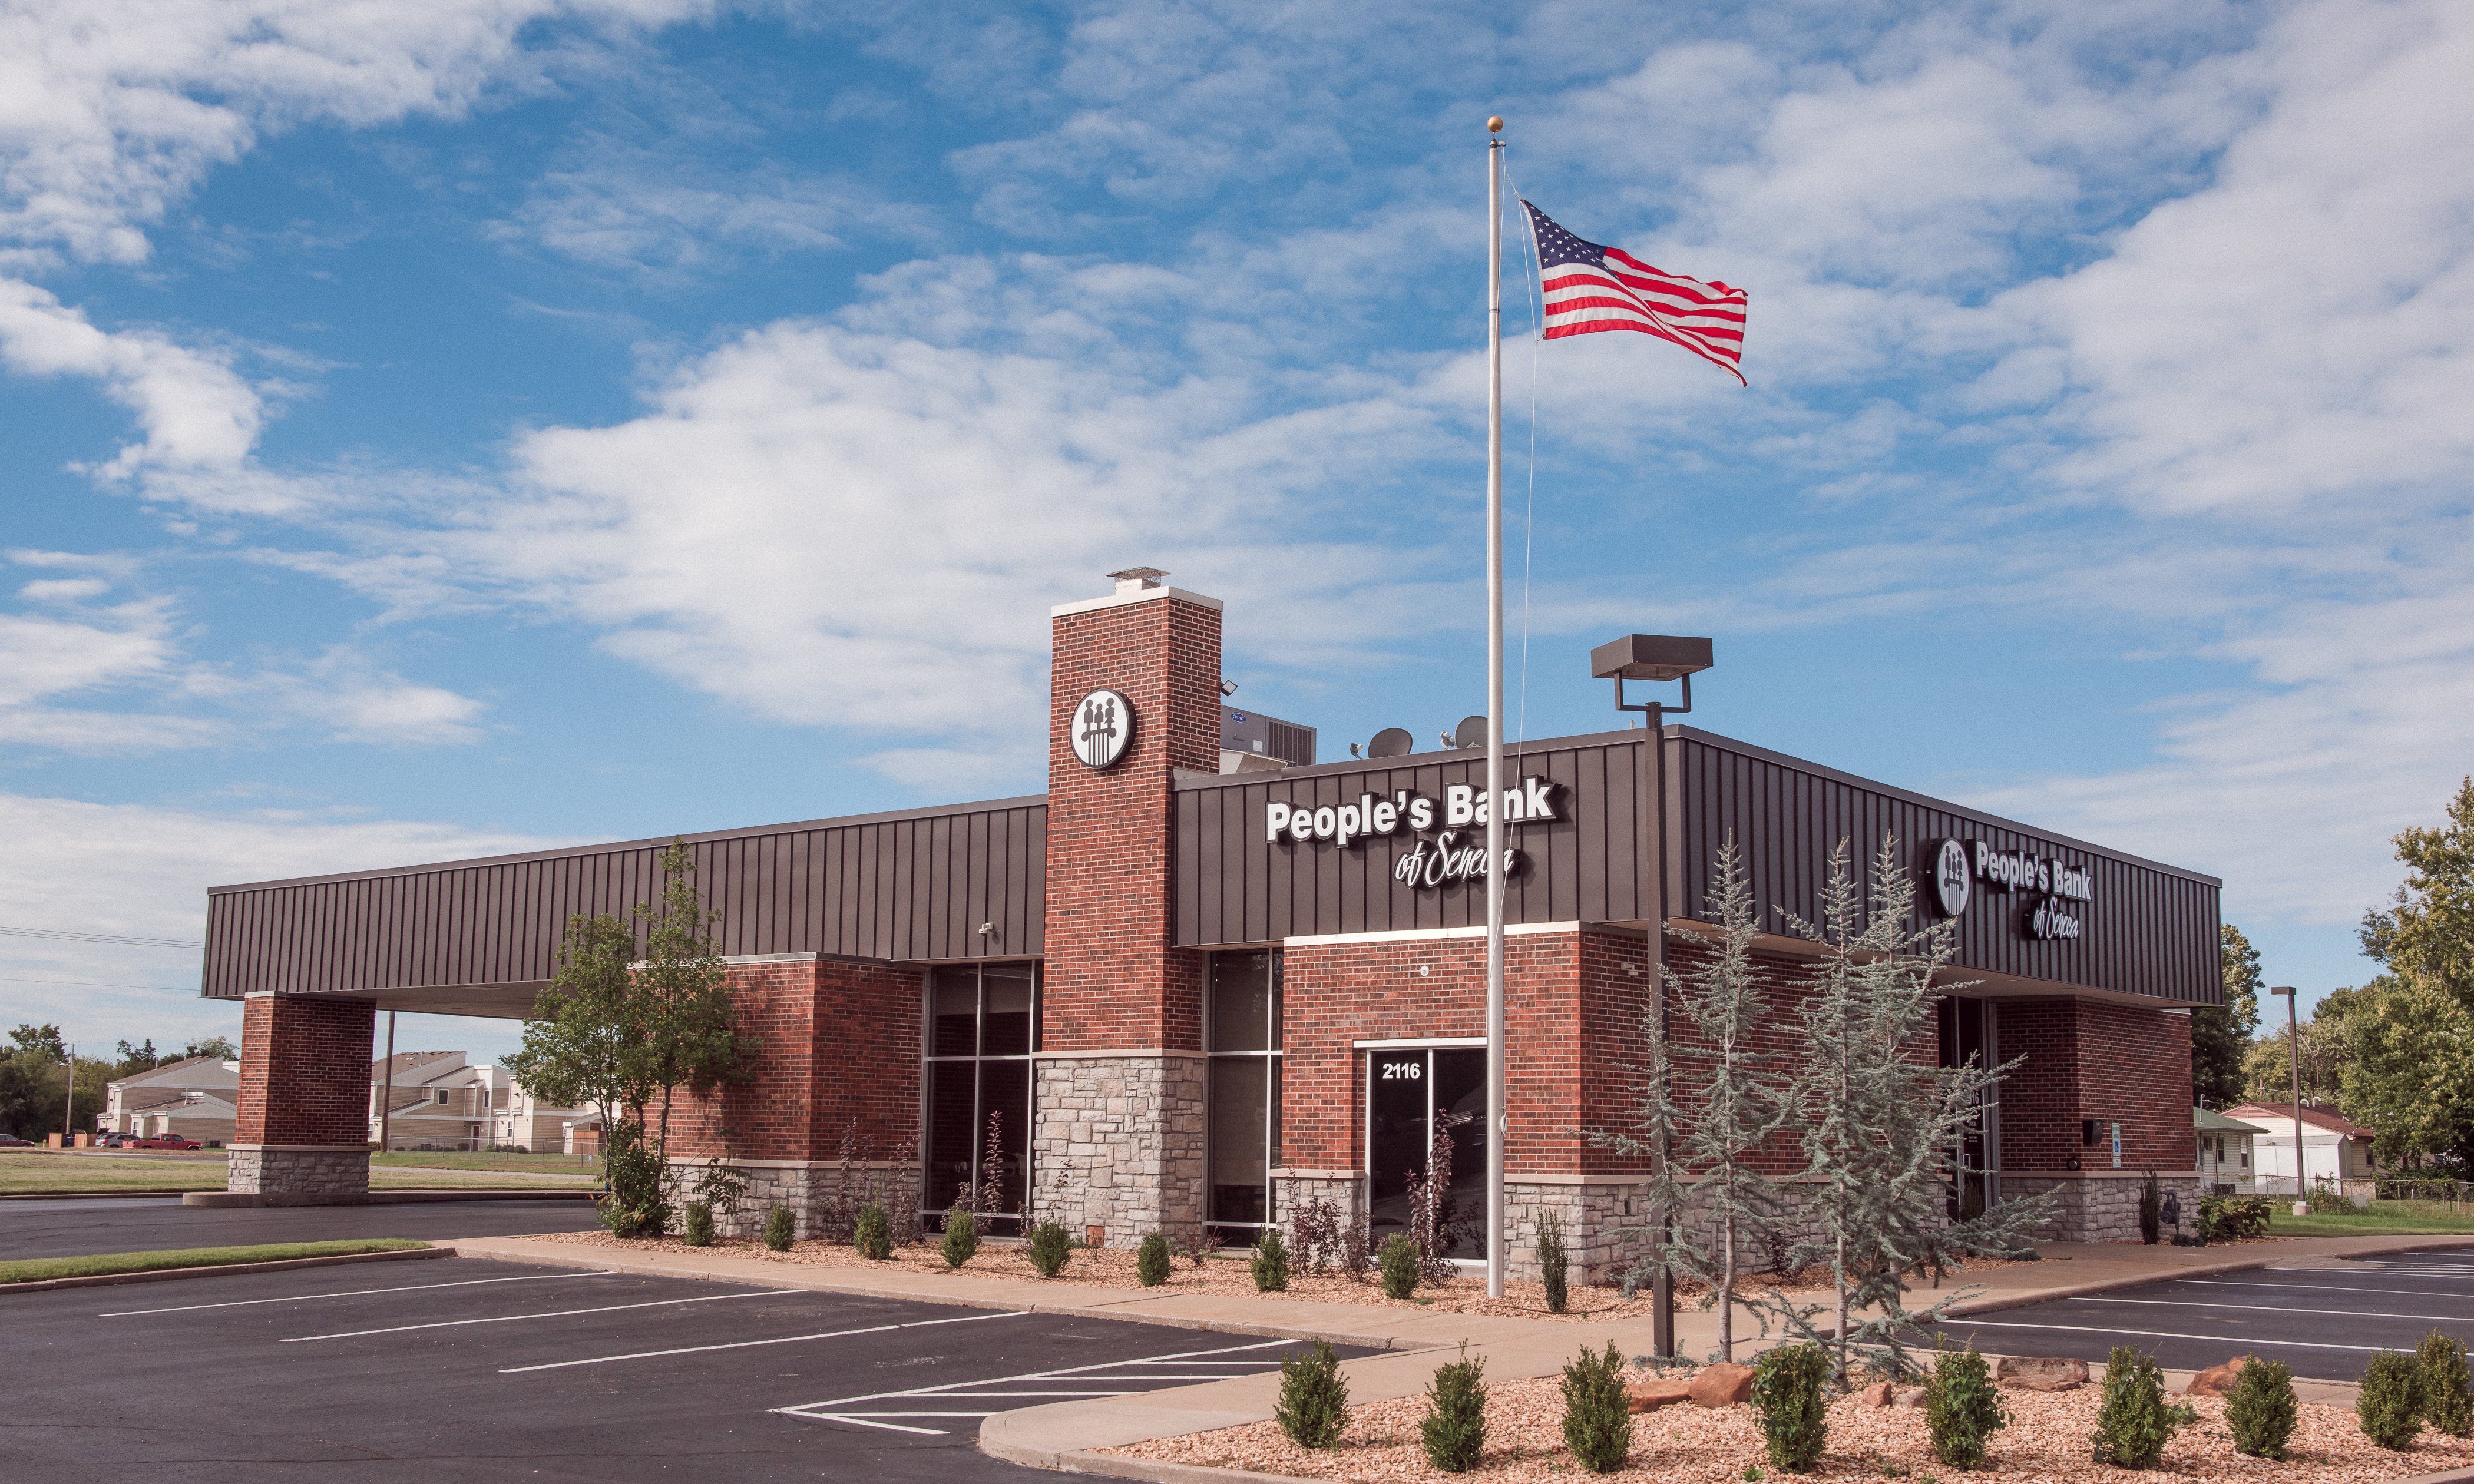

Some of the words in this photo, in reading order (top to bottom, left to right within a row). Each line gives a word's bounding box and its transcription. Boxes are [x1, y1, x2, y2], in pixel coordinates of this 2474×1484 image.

[1266, 790, 1434, 846] People's
[1446, 777, 1556, 825] Bank
[1395, 840, 1426, 887] of
[1976, 840, 2049, 892] People's
[2053, 859, 2092, 901] Bank
[2033, 900, 2046, 938] of
[2046, 896, 2079, 939] Seneca
[1382, 1062, 1420, 1079] 2116
